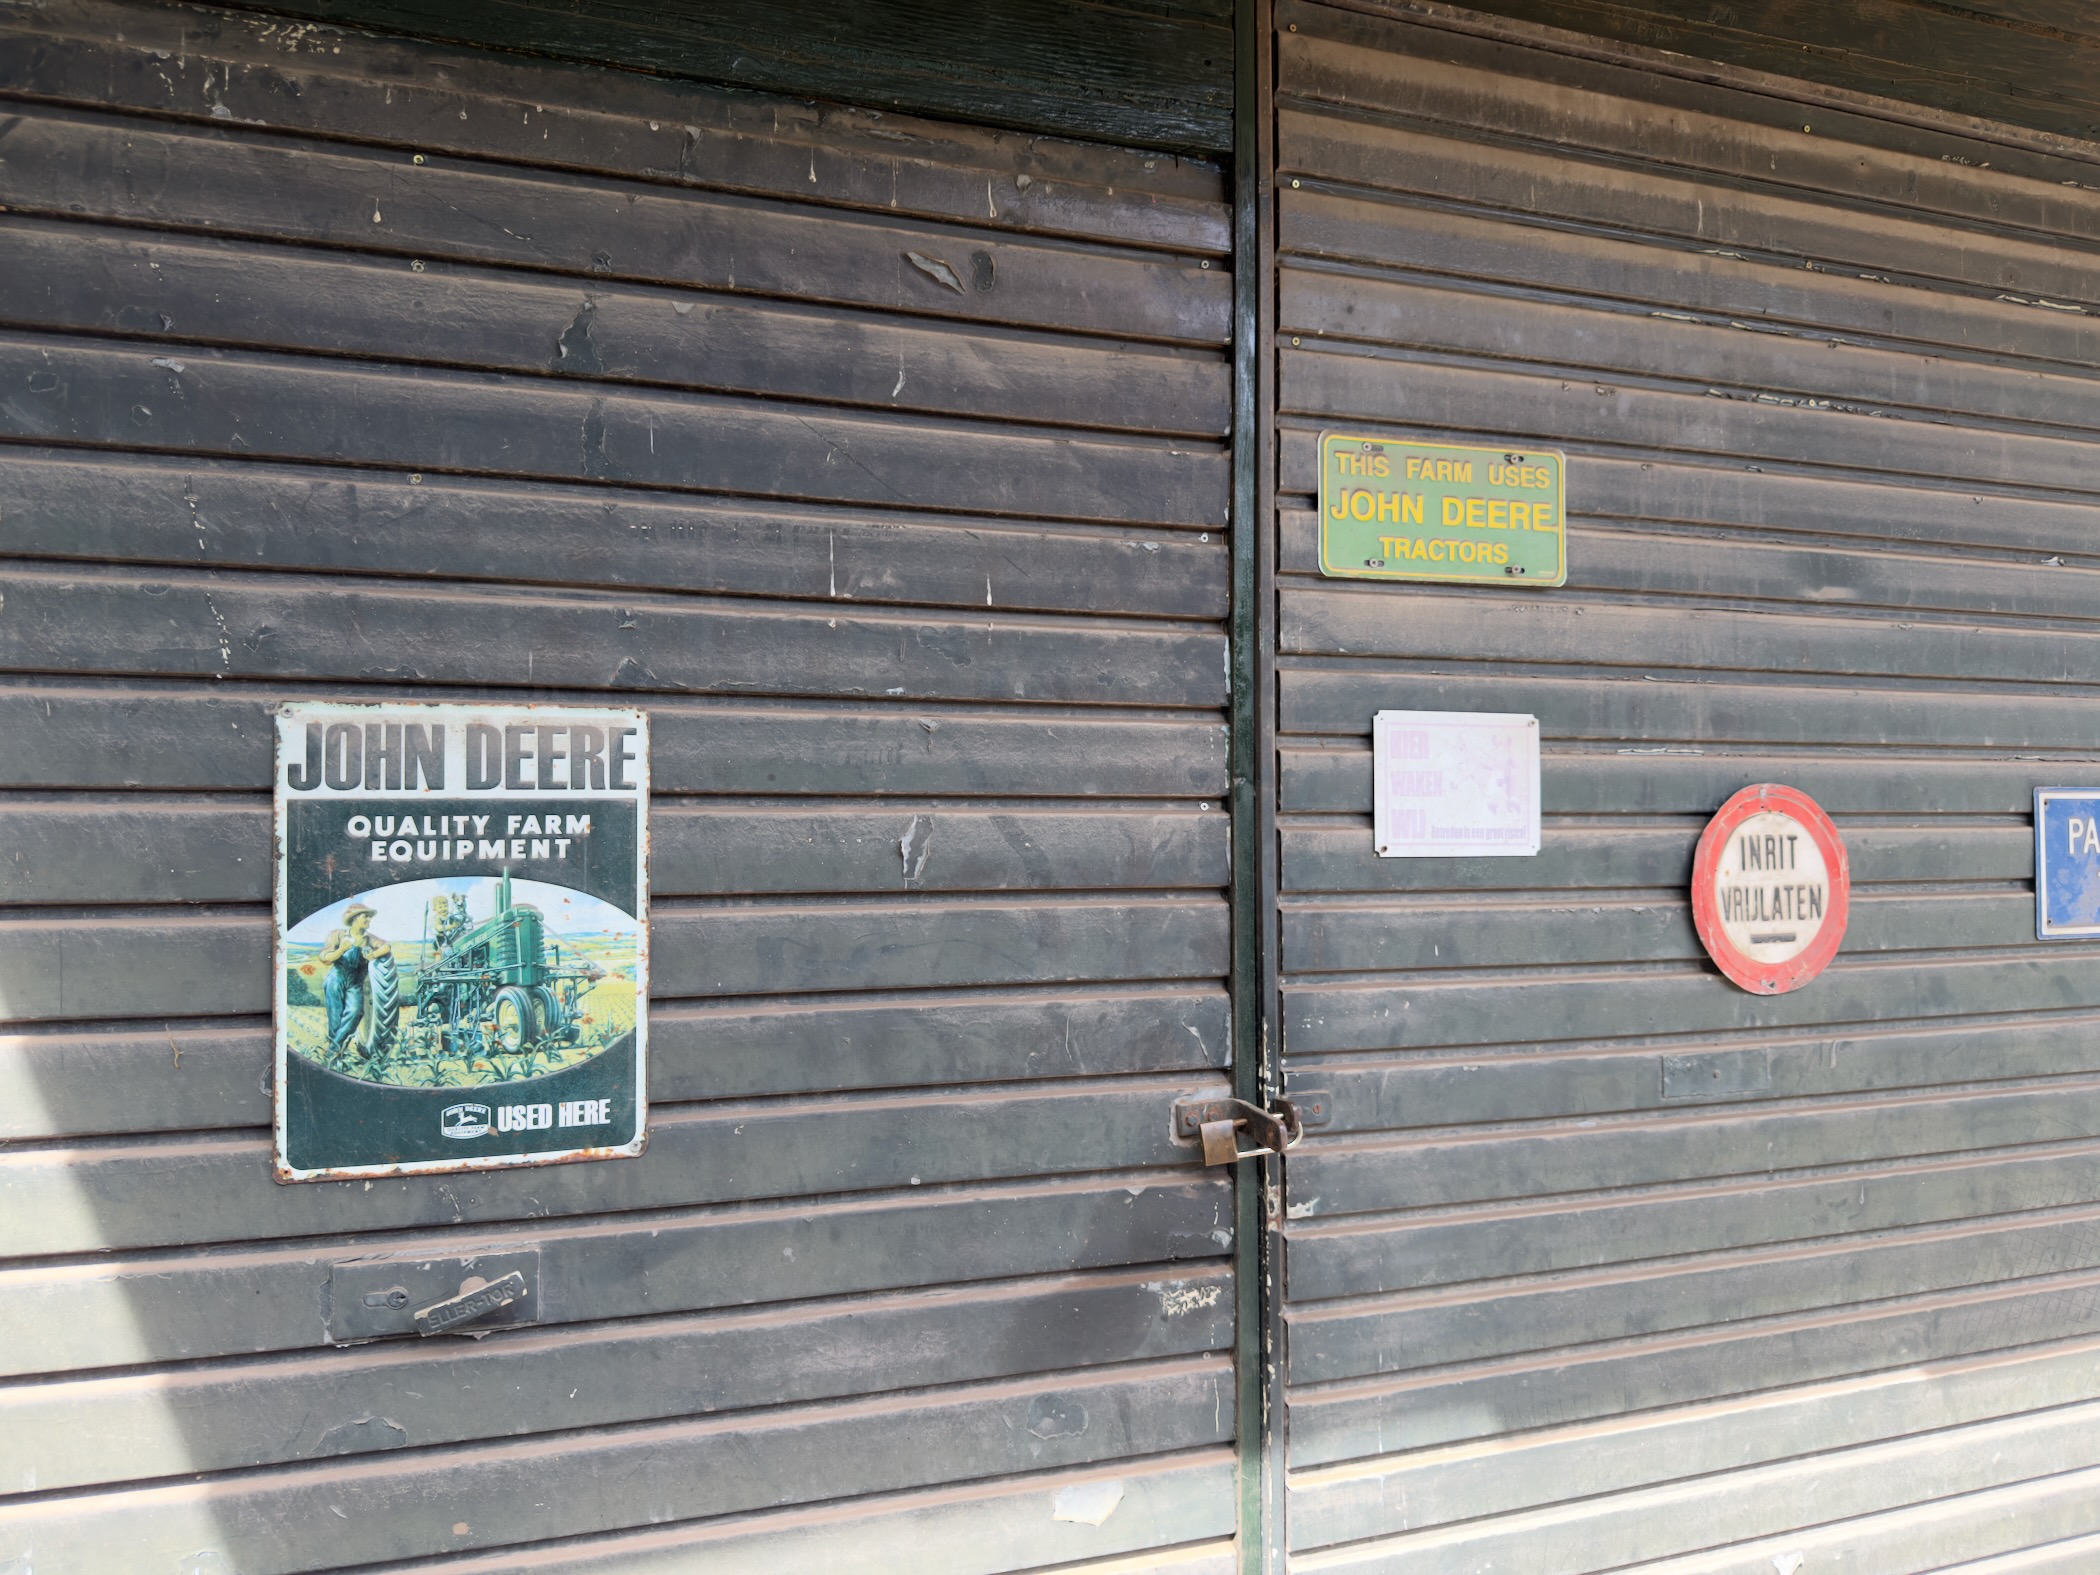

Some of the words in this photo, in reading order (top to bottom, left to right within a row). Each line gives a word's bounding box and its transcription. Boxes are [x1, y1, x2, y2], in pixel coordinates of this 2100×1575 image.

[1334, 451, 1391, 478] THIS
[1406, 457, 1472, 483] FARM
[1488, 464, 1551, 489] USES
[1330, 488, 1424, 525] JOHN
[1442, 496, 1553, 532] DEERE
[1378, 536, 1509, 565] TRACTORS
[287, 722, 446, 791] JOHN
[466, 722, 638, 791] DEERE
[347, 814, 492, 838] QUALITY
[507, 814, 591, 835] FARM
[371, 838, 573, 862] EQUIPMENT
[1740, 834, 1798, 871] INRIT
[1721, 884, 1822, 922] VRIJLATEN
[497, 1103, 553, 1132] USED
[558, 1099, 611, 1129] HERE
